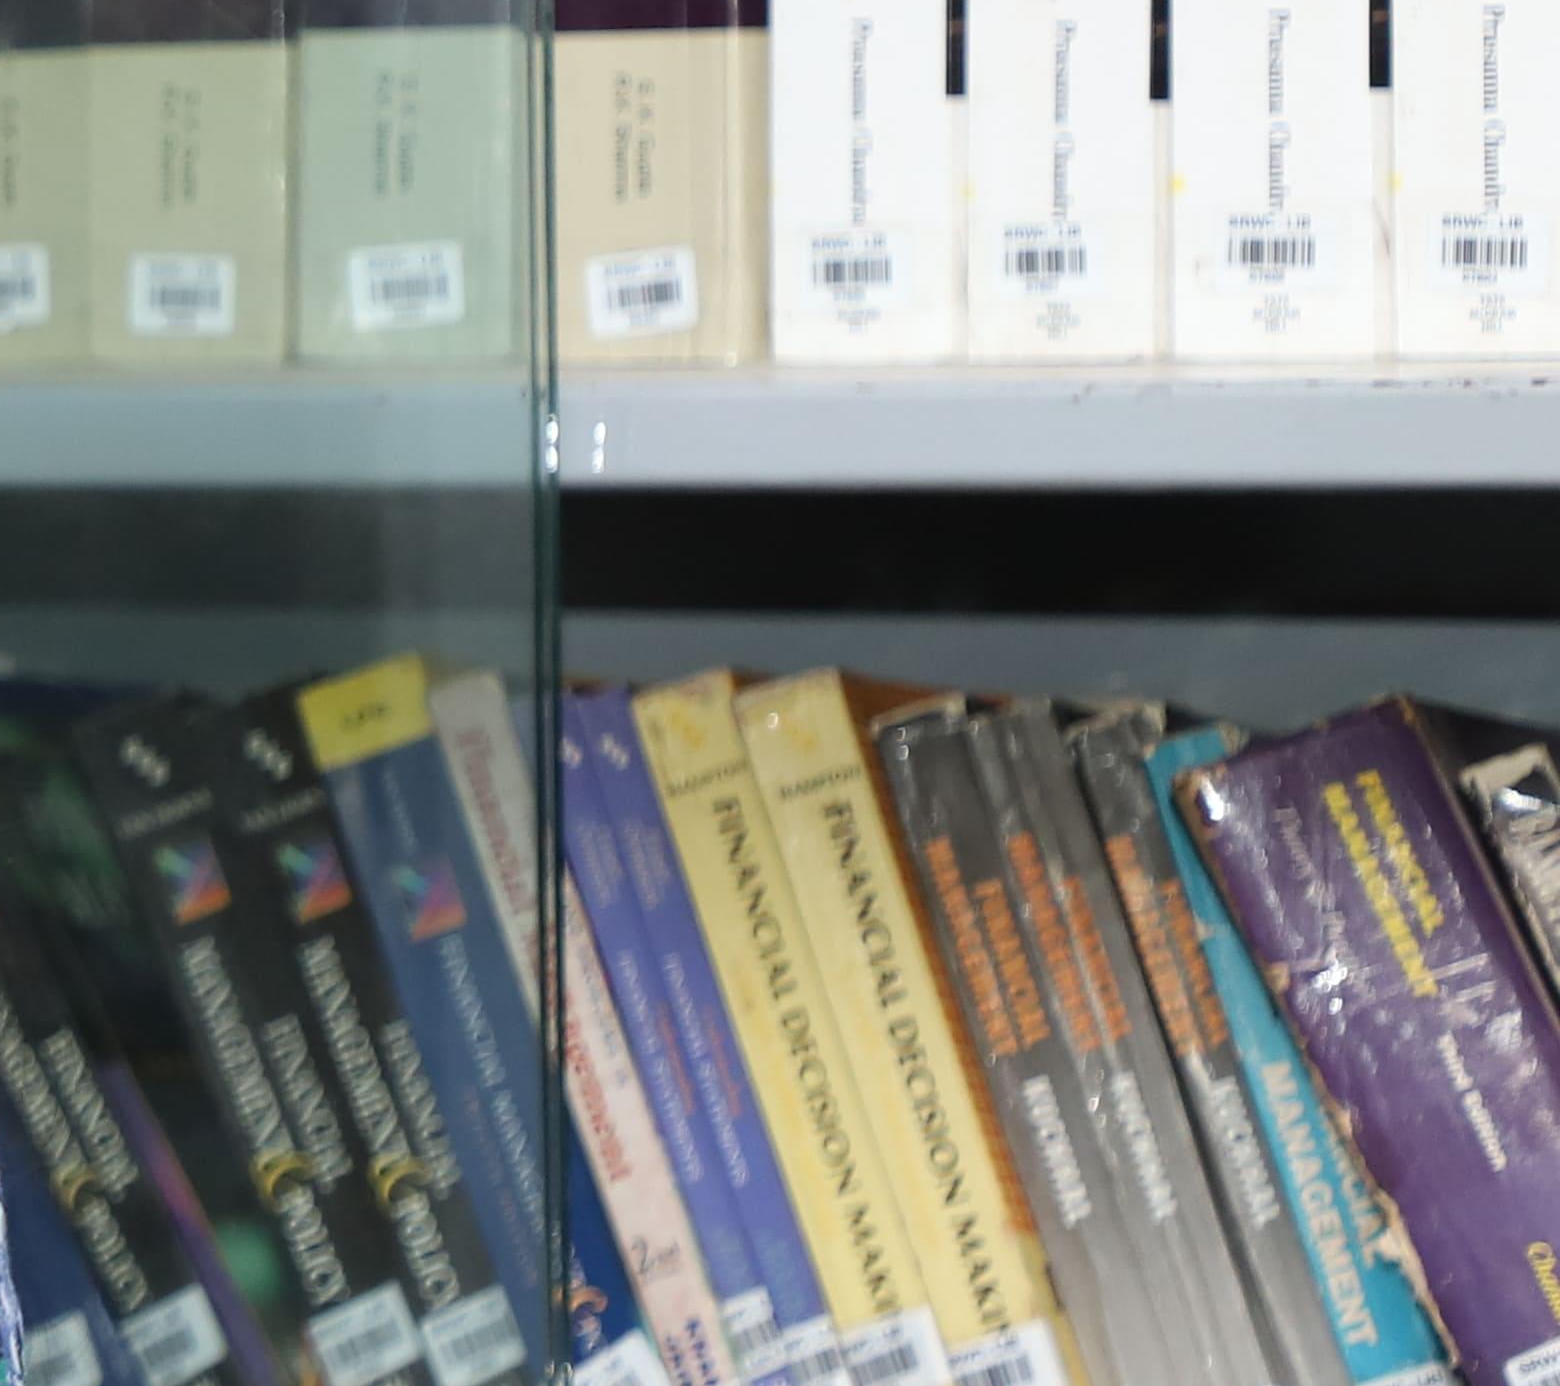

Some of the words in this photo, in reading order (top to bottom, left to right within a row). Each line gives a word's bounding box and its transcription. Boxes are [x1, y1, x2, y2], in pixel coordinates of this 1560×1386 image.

[712, 796, 797, 1001] FINANCIAL
[780, 1004, 862, 1199] DECISION
[820, 798, 909, 1010] FINANCIAL
[887, 1014, 972, 1208] DECISION
[1260, 1060, 1380, 1348] MANAGEMENT
